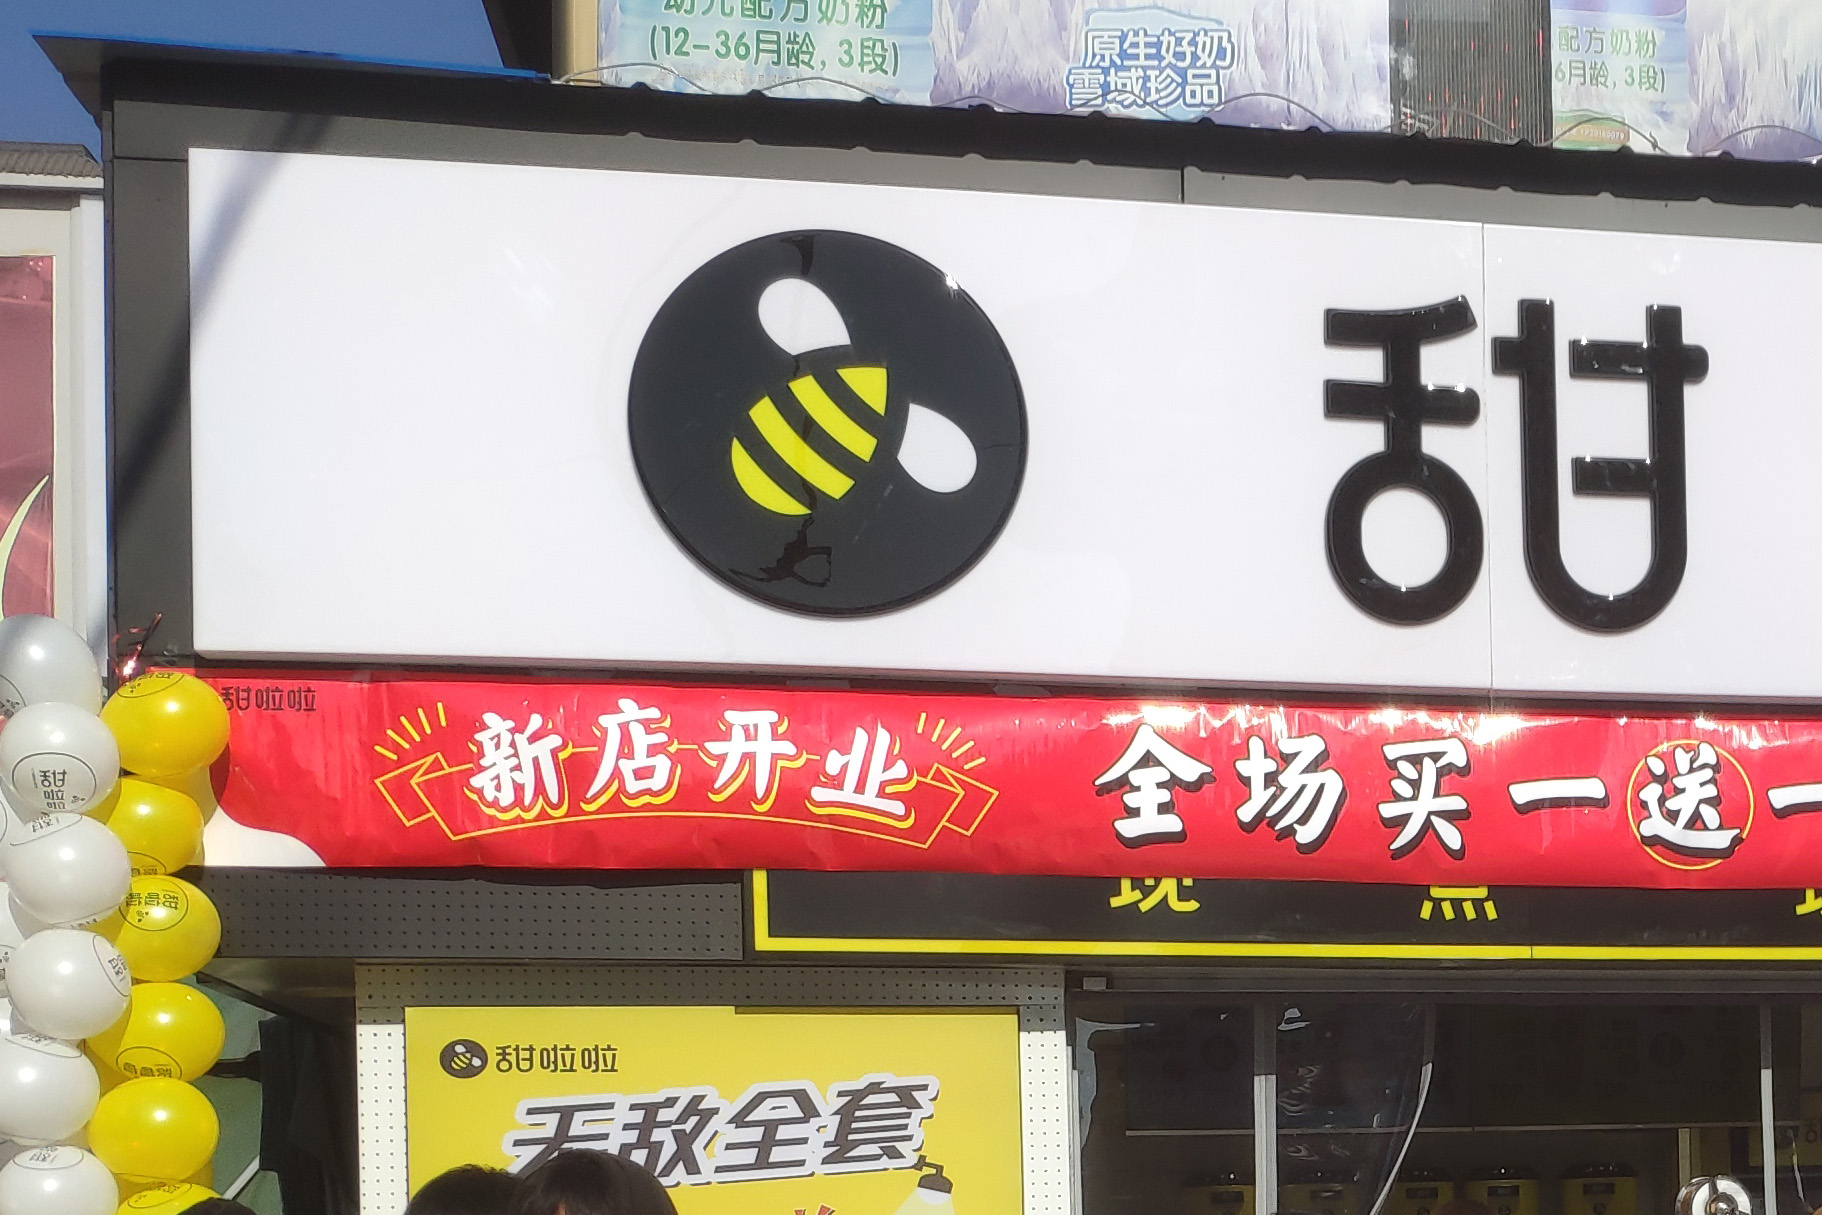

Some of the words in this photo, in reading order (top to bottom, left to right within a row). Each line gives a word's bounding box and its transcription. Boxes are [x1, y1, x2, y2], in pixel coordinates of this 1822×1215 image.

[1084, 28, 1232, 69] 原生好奶
[1068, 67, 1221, 108] 雪域珍品
[466, 697, 912, 822] 新店开业
[494, 1043, 619, 1075] 甜啦啦
[508, 1078, 936, 1182] 无敌全套
